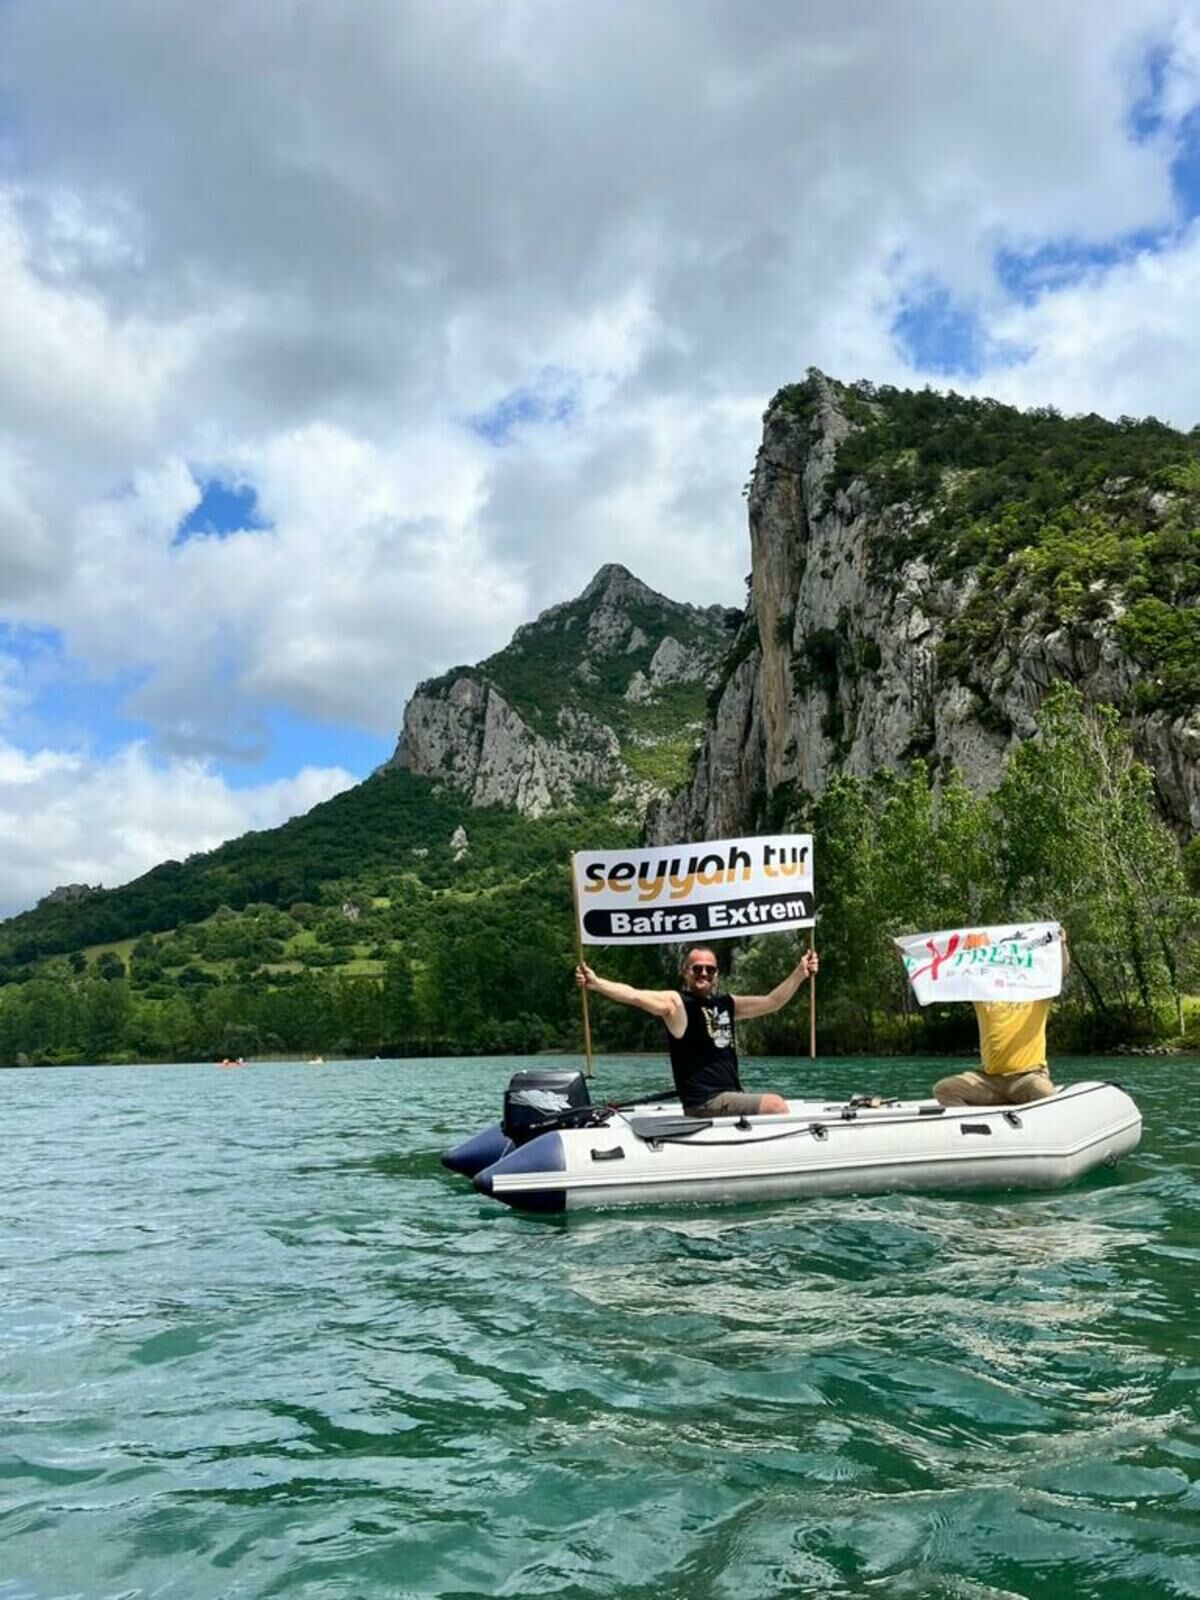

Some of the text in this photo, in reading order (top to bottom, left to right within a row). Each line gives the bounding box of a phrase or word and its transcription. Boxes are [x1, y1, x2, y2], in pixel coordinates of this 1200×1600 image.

[584, 845, 808, 901] seyyah tur
[610, 899, 806, 934] Bafra Extrem
